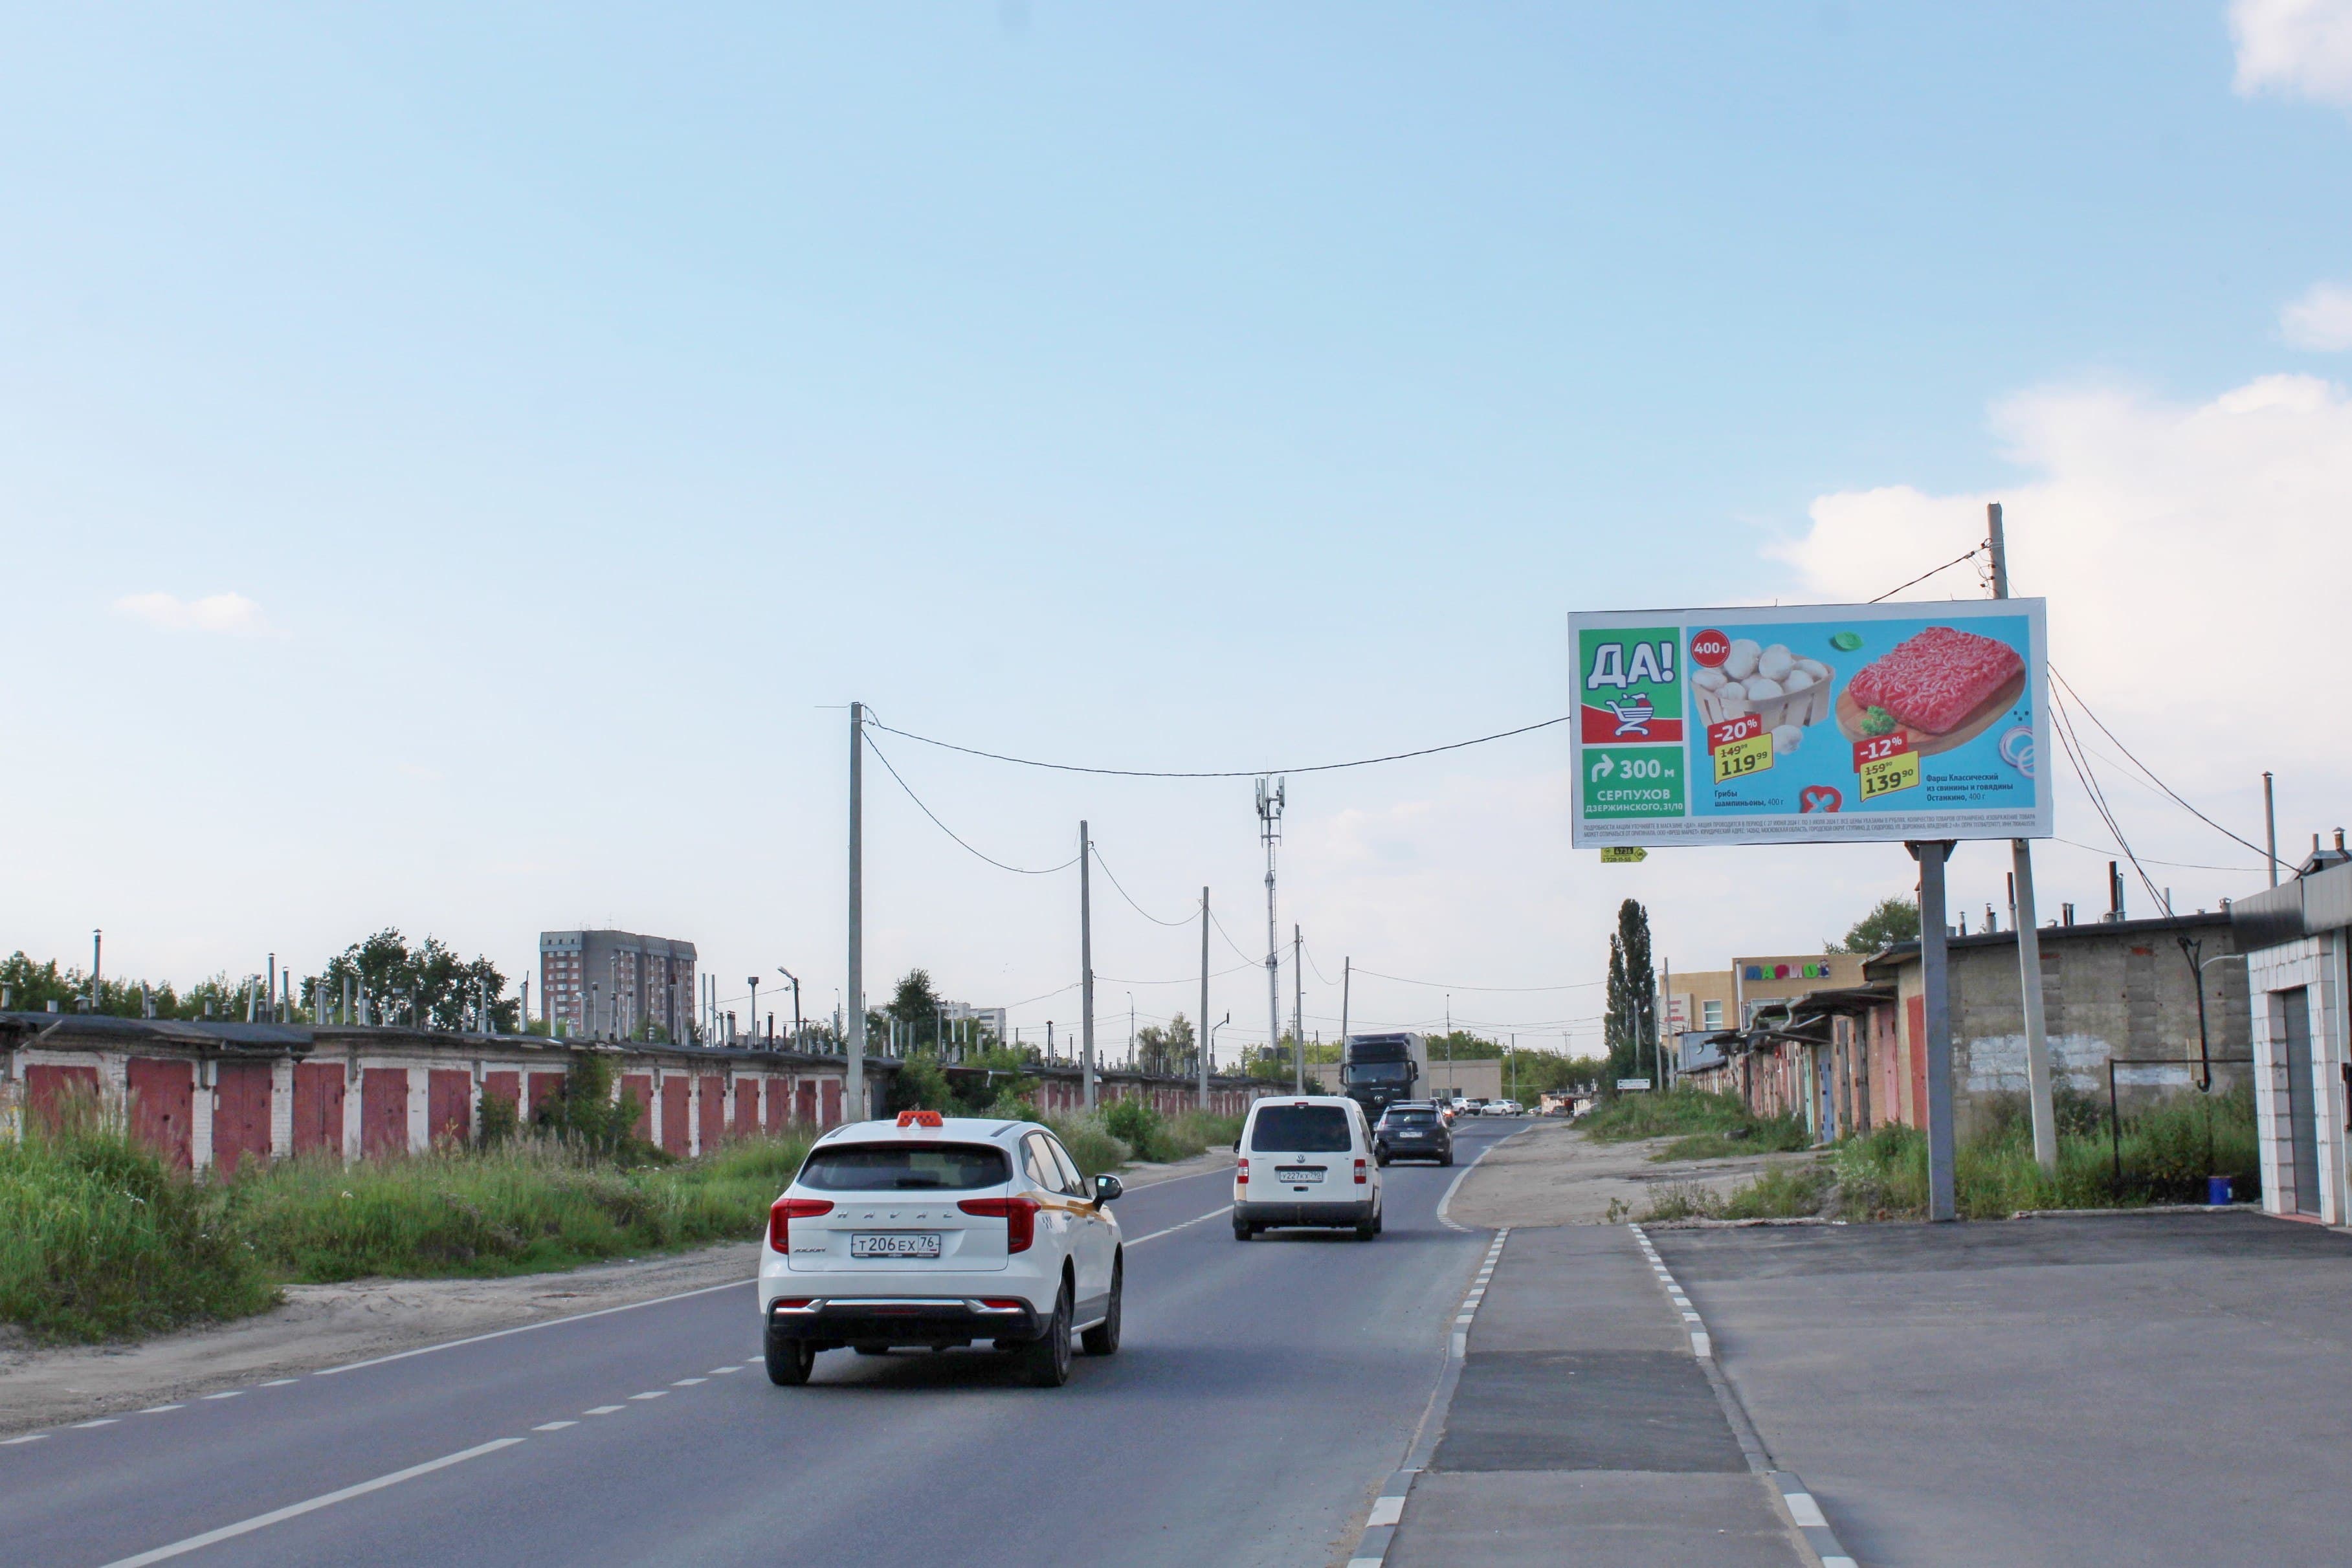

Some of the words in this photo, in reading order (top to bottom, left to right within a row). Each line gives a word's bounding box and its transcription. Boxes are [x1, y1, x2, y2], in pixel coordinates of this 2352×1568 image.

[1694, 643, 1720, 654] 400
[1588, 641, 1675, 690] ДА!
[1714, 718, 1757, 742] -20%
[1860, 736, 1902, 759] -12%
[1620, 759, 1661, 778] 300
[1664, 769, 1674, 777] м
[1926, 774, 1947, 783] Фарш
[1597, 789, 1670, 801] СЕРПУХОВ
[1714, 790, 1737, 799] Грибы
[1745, 962, 1819, 980] МАРИО
[859, 1237, 916, 1252] Т206ЕХ
[920, 1237, 934, 1248] 76
